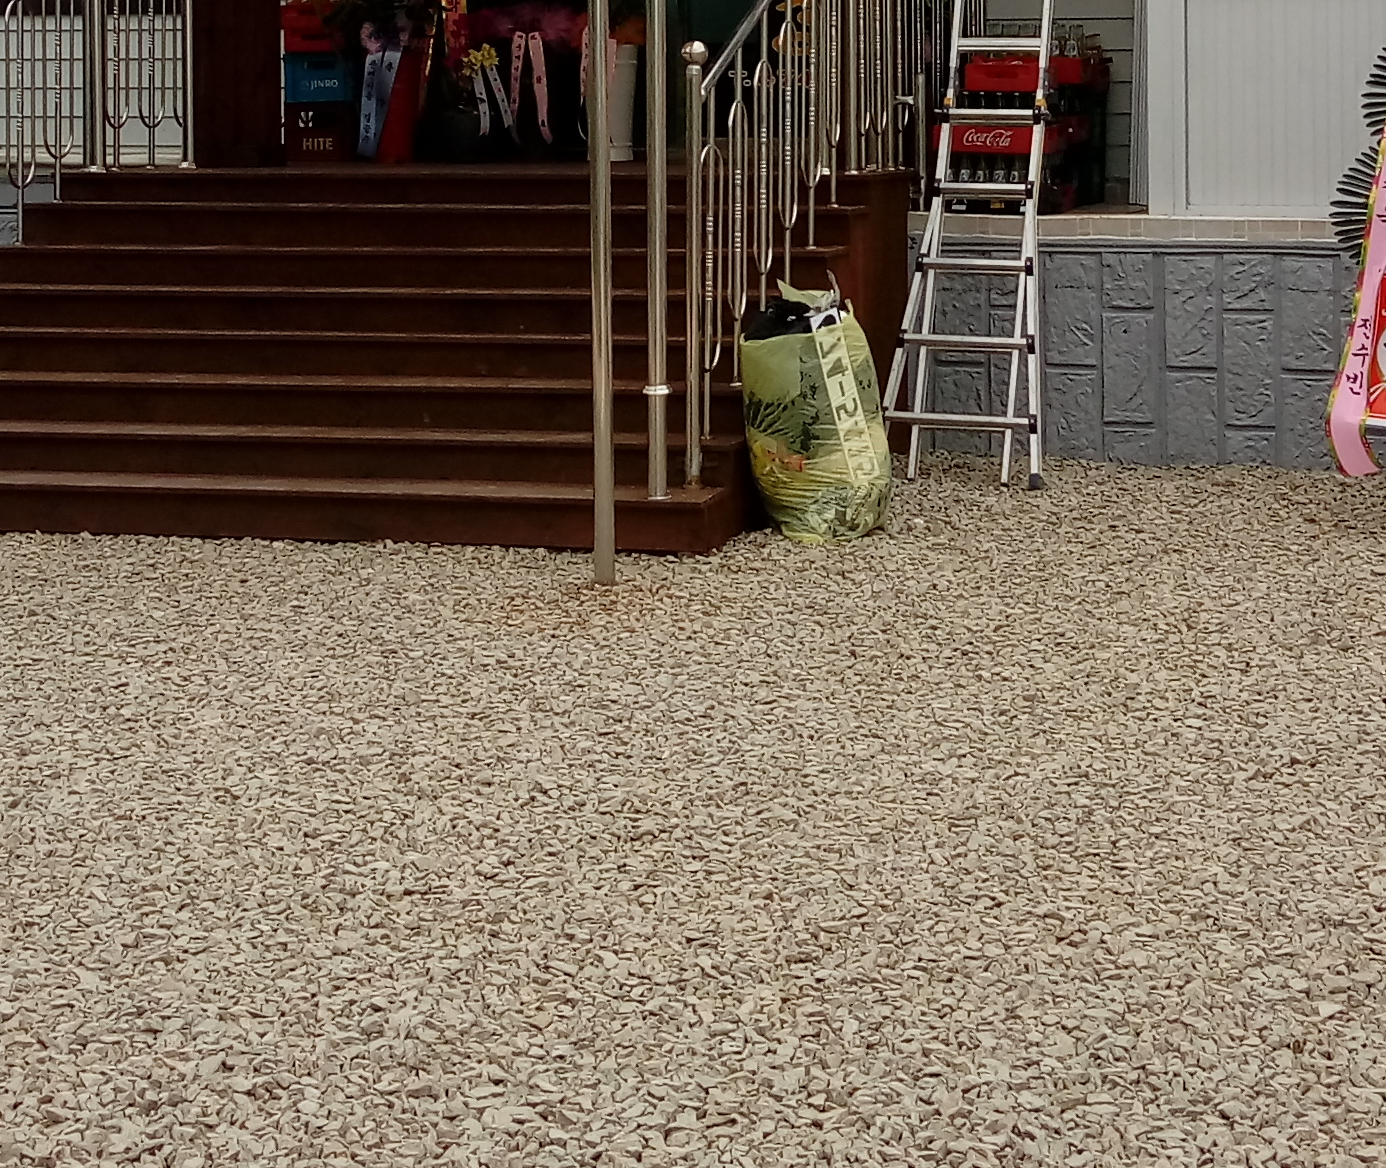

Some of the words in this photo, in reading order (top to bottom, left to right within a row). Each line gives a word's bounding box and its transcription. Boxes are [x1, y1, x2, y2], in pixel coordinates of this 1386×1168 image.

[310, 78, 339, 91] JINRO
[302, 137, 334, 152] HITE
[963, 128, 1014, 149] Coca-Cola
